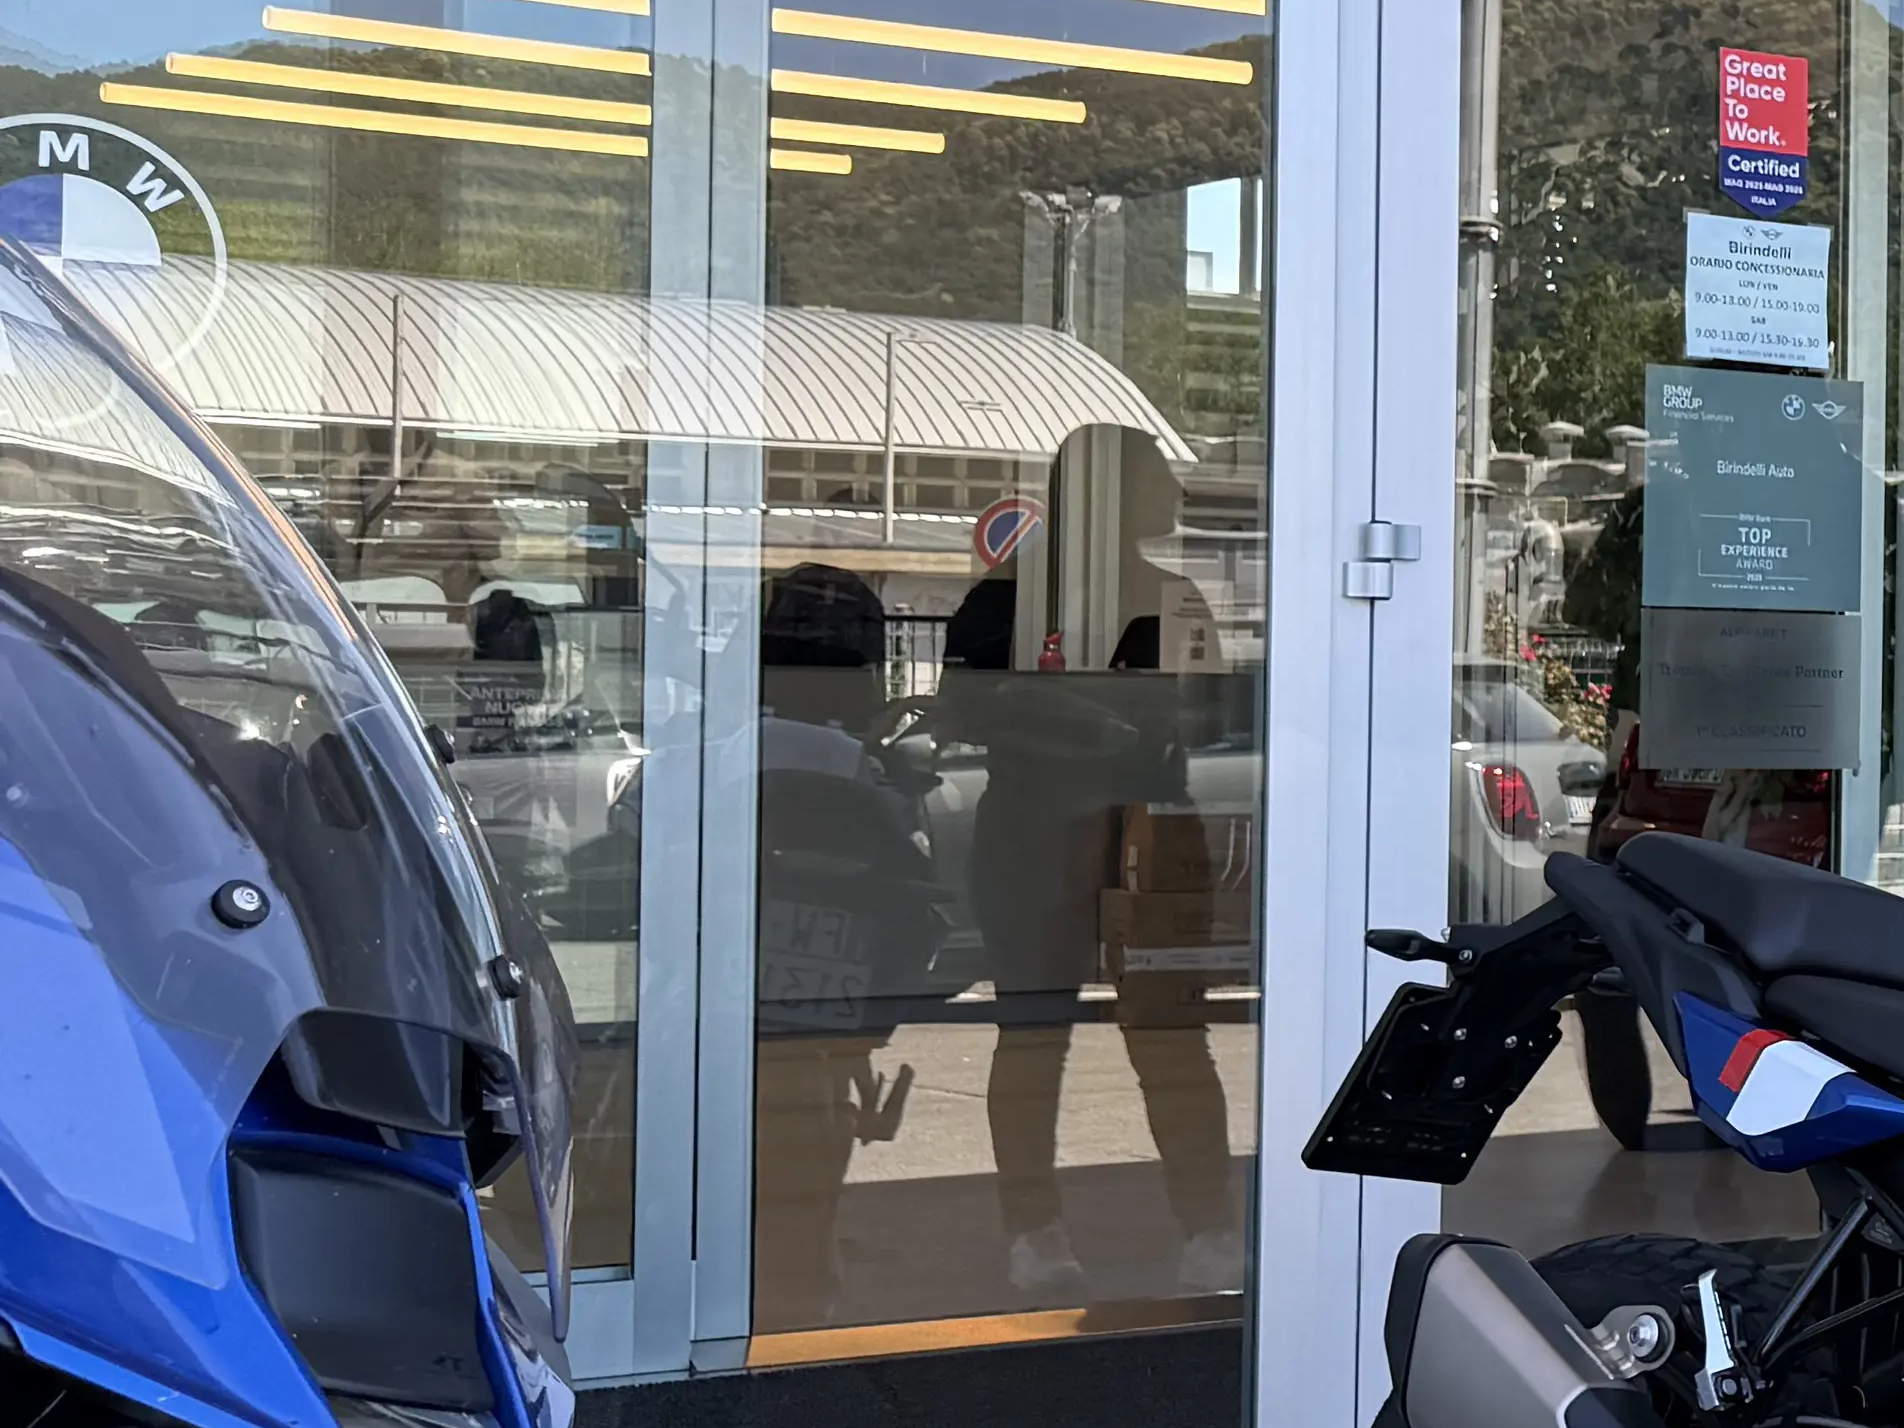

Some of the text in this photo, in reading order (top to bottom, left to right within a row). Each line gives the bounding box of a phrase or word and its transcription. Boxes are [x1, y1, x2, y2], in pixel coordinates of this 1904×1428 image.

[1724, 54, 1787, 81] Great
[1726, 75, 1785, 102] Place
[1724, 98, 1748, 119] To
[1725, 120, 1787, 146] Work.
[1728, 154, 1800, 178] Certified
[1729, 240, 1792, 260] Birindelli
[1735, 260, 1825, 280] CONCESSIONARIA
[1663, 384, 1693, 397] BMW
[1663, 396, 1703, 410] GROUP
[1717, 460, 1795, 478] Birindelli Auto
[1738, 527, 1772, 544] TOP
[1720, 544, 1788, 558] EXPERIENCE
[1736, 558, 1774, 570] AWARD
